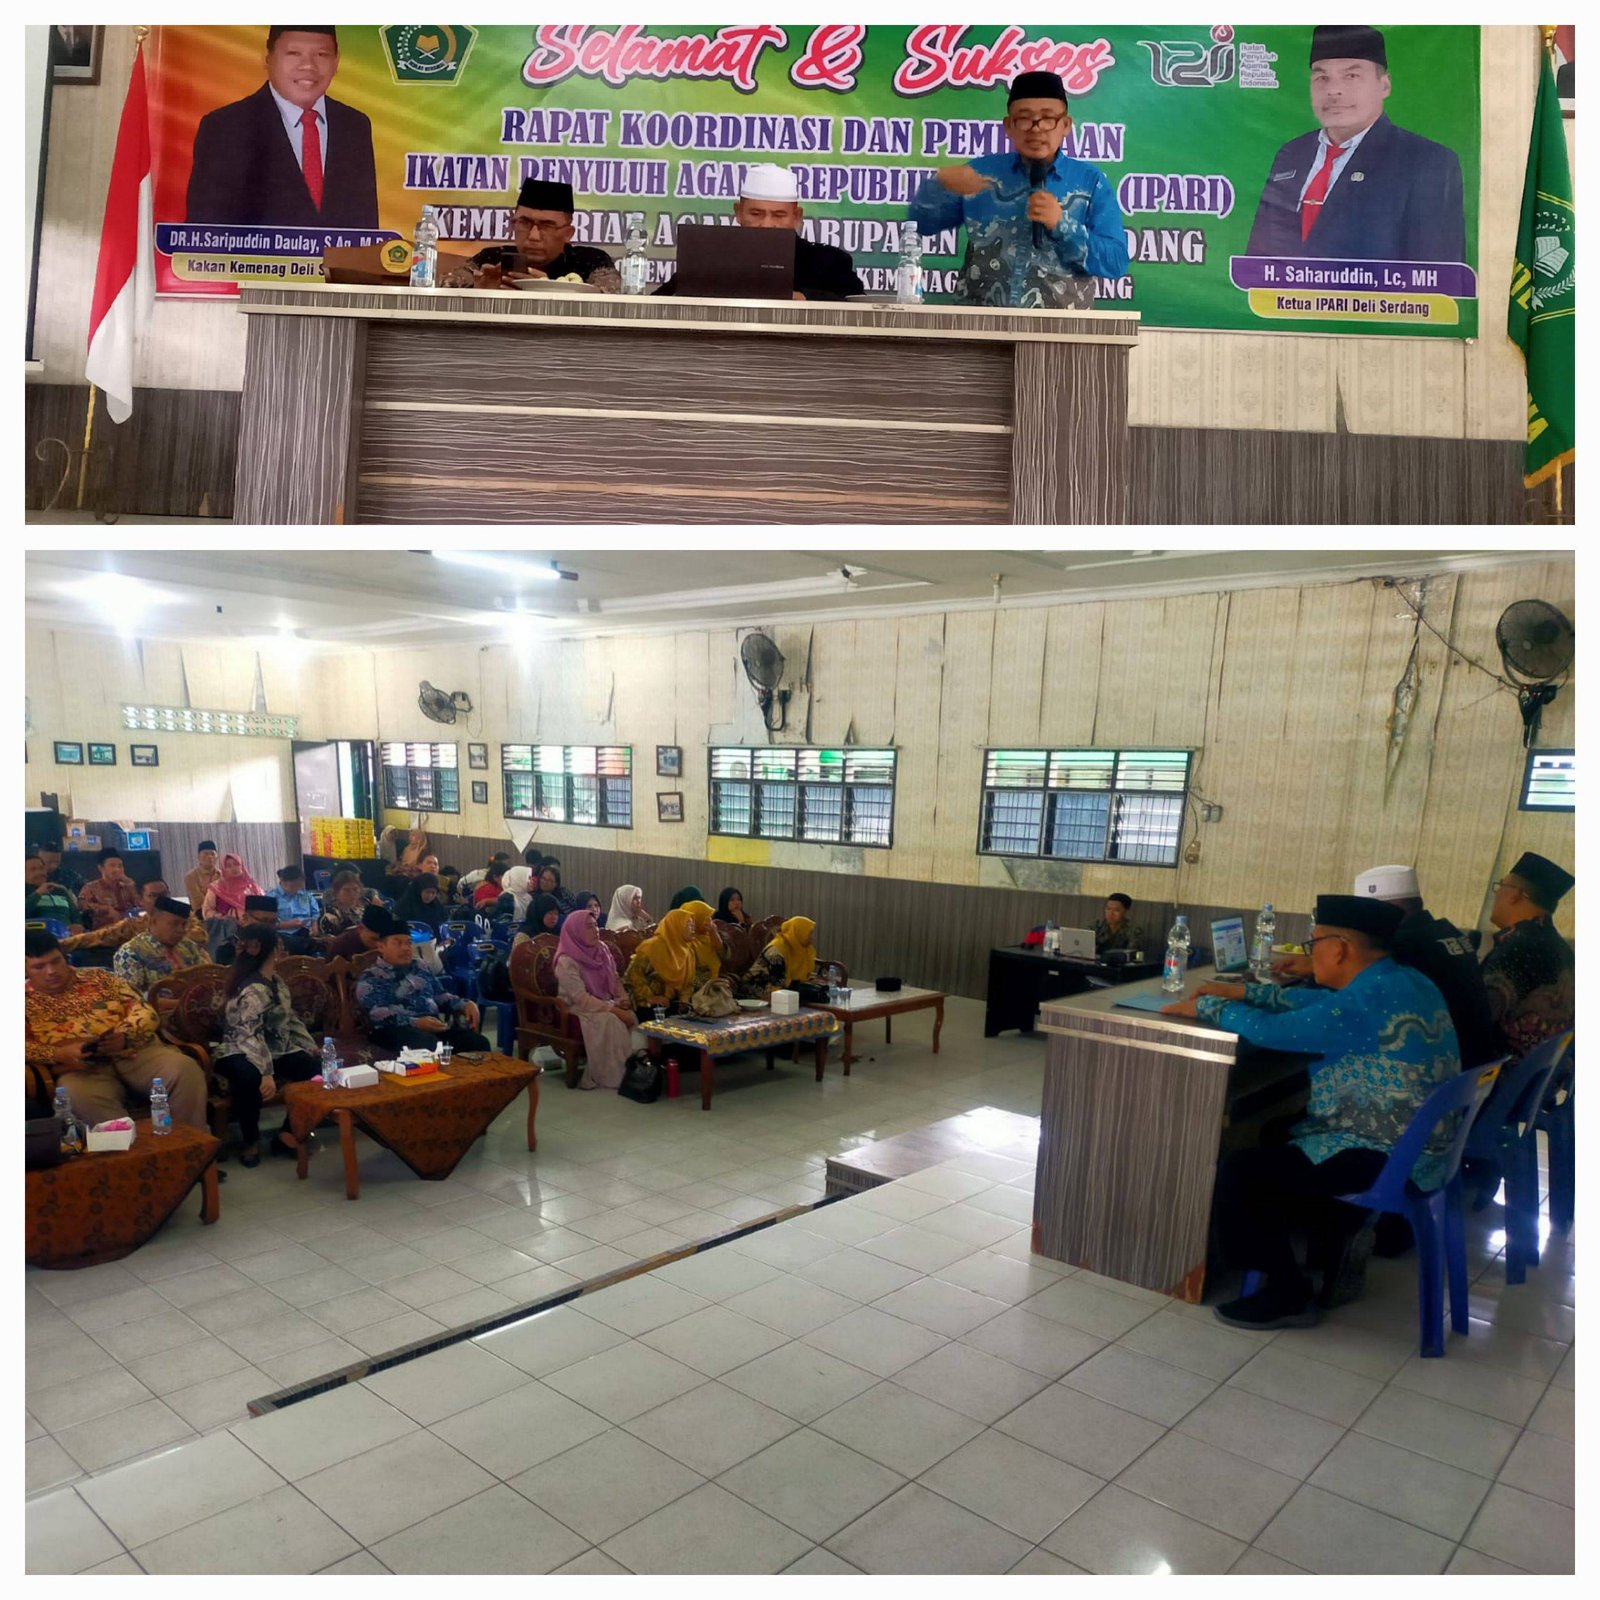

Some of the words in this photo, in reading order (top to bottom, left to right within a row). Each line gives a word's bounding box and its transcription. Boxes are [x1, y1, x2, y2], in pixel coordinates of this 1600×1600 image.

[526, 25, 785, 87] Selamat
[793, 25, 861, 89] &
[896, 25, 1114, 92] Sukses
[501, 109, 611, 145] RAPAT
[620, 112, 833, 151] KOORDINASI
[844, 119, 912, 154] DAN
[404, 154, 509, 190] IKATAN
[520, 157, 667, 195] PENYULUH
[1119, 175, 1233, 217] (IPARI)
[170, 230, 270, 252] DR.H.Saripuddin
[274, 233, 320, 254] Daulay,
[188, 259, 226, 273] Kakan
[229, 261, 286, 277] Kemenag
[290, 263, 315, 275] Deli
[1264, 264, 1280, 282] H.
[1285, 265, 1379, 287] Saharuddin,
[1384, 268, 1406, 288] Lc,
[1412, 269, 1438, 287] MH
[1277, 296, 1312, 310] Ketua
[1316, 297, 1348, 312] IPARI
[1353, 299, 1376, 313] Deli
[1380, 300, 1430, 317] Serdang
